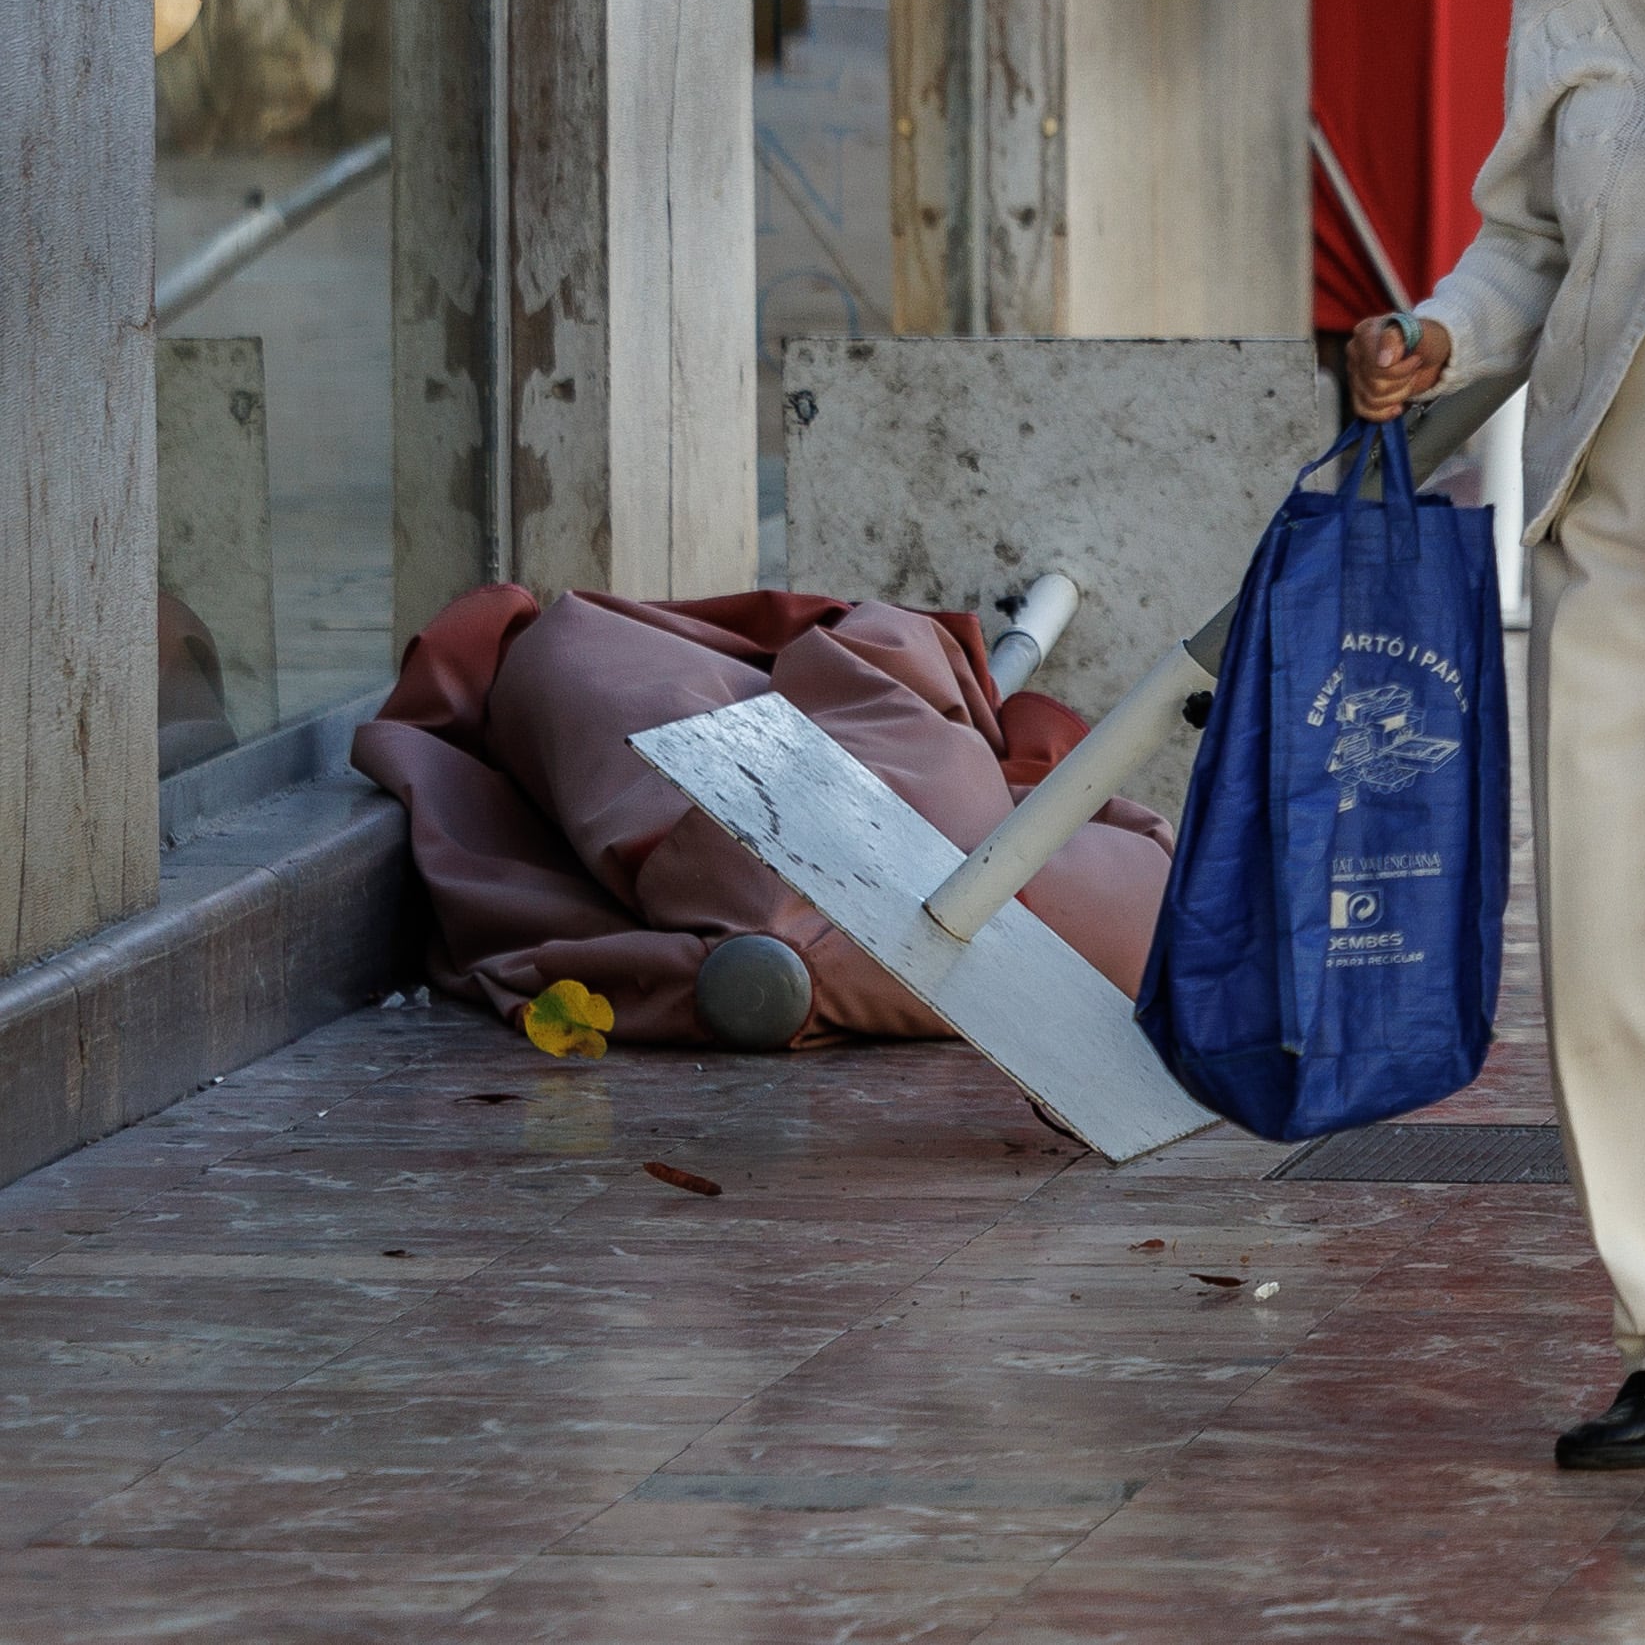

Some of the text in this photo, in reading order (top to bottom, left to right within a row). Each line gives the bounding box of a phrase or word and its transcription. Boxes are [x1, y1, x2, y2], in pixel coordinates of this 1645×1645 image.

[1341, 633, 1405, 657] ARTÓ
[1408, 645, 1418, 662] I
[1360, 852, 1441, 871] VALENCIANA
[1335, 957, 1364, 968] PARA
[1368, 951, 1425, 966] RECICLAR
